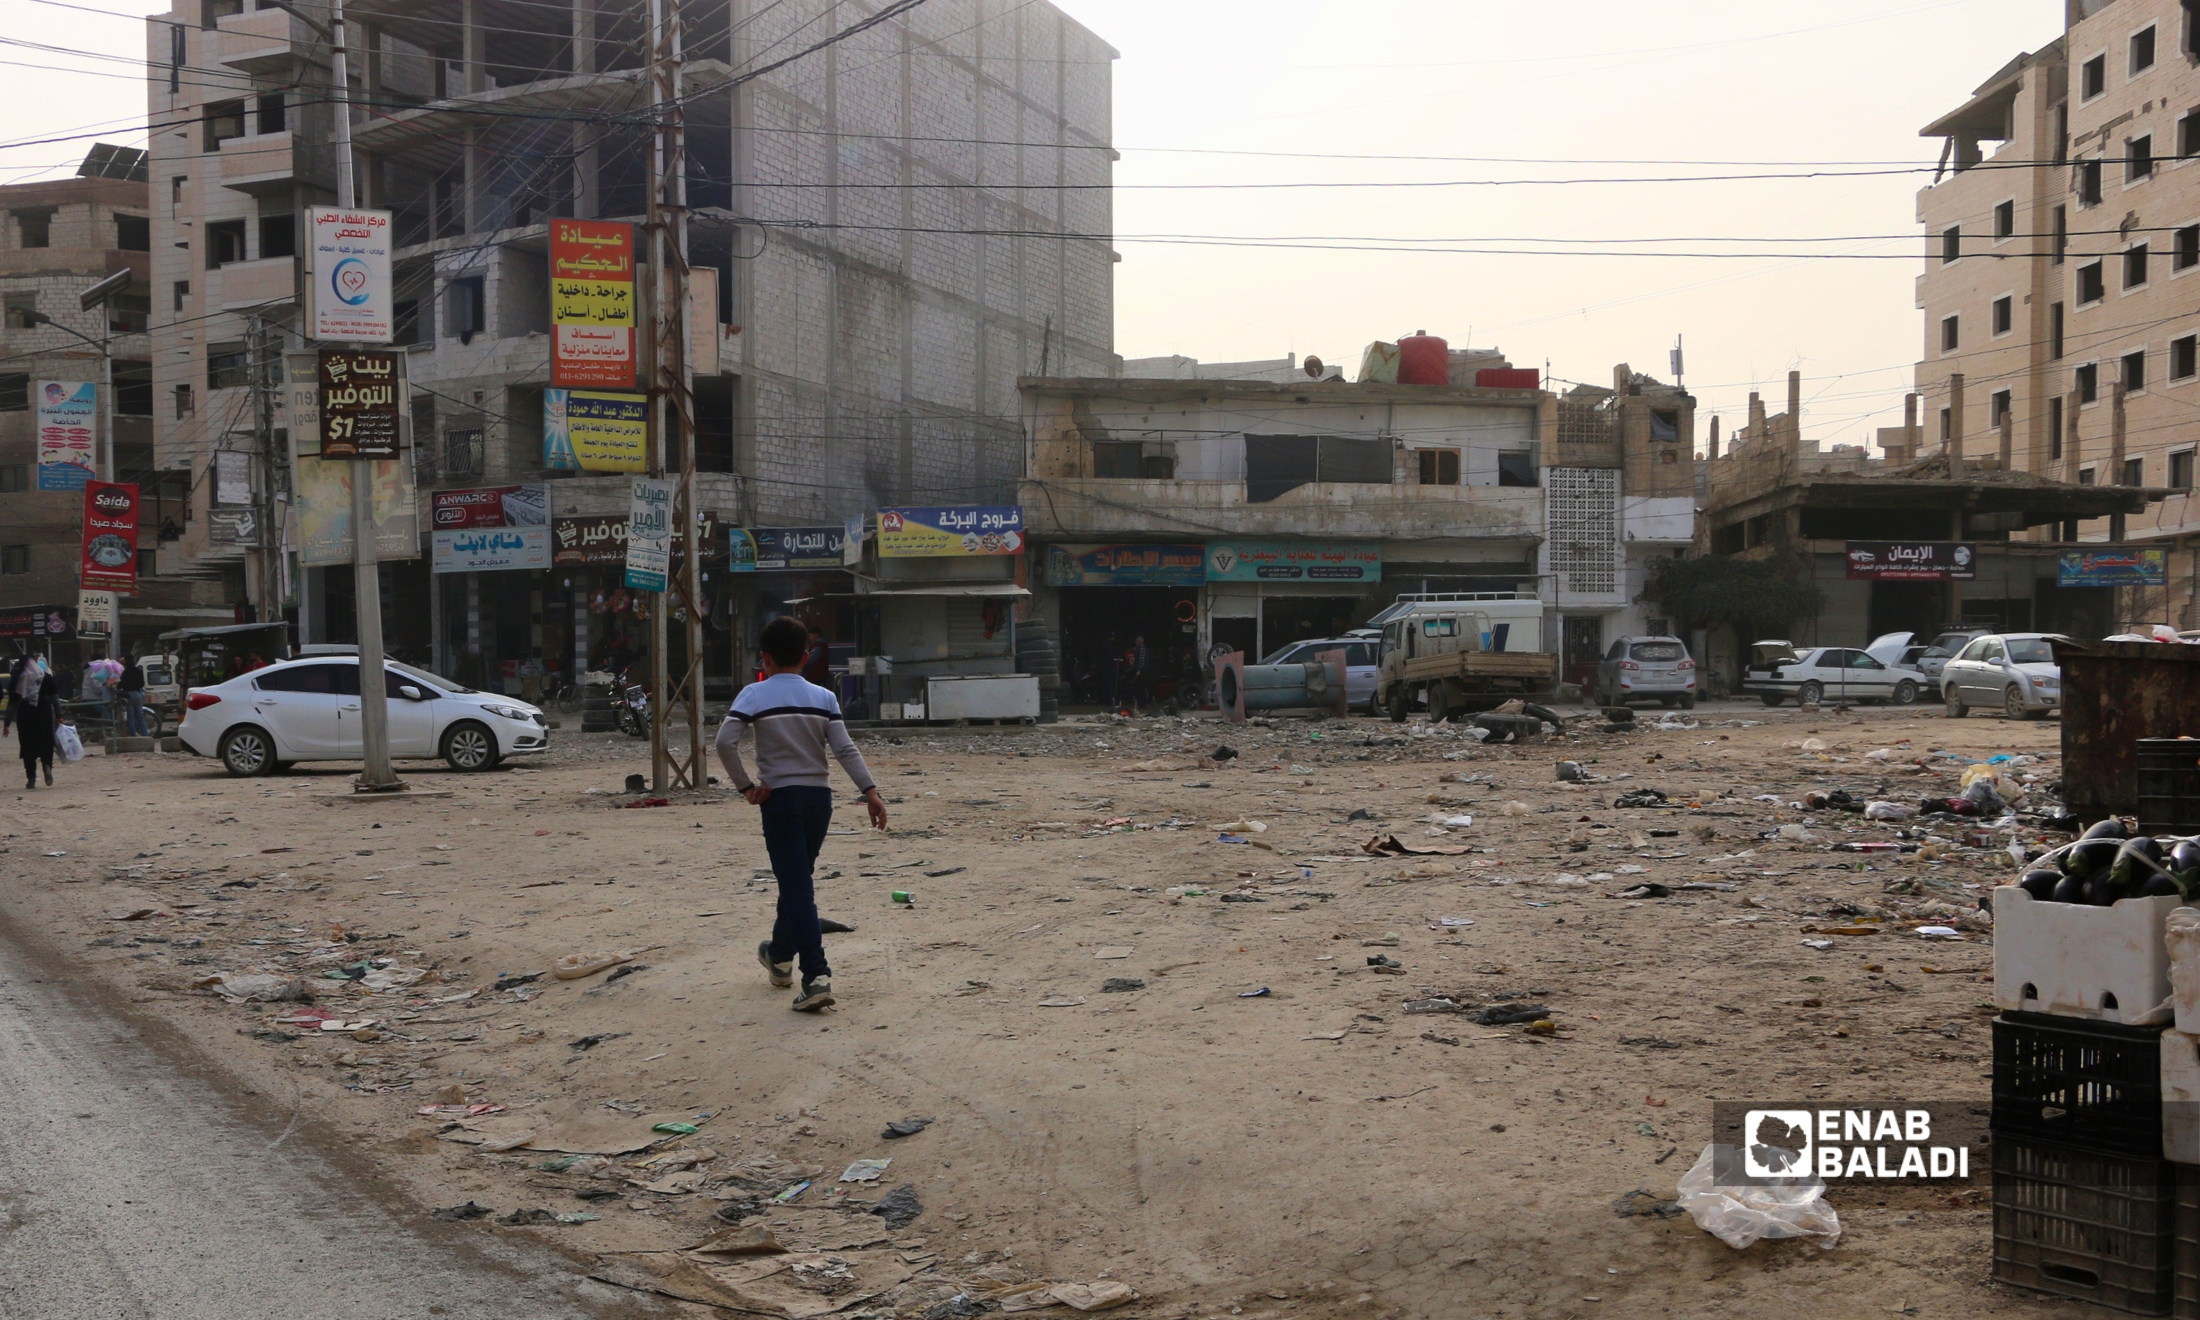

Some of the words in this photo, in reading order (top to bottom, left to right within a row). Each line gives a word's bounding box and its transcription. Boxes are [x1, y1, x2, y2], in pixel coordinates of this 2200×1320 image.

[317, 214, 339, 226] الطبي
[342, 214, 365, 224] الشفاء
[367, 217, 386, 228] مركز
[335, 229, 370, 240] التخصصي
[560, 225, 623, 249] عيادة
[557, 253, 628, 274] الحكيم
[558, 283, 589, 298] داخلية
[597, 285, 627, 301] جراحة
[557, 304, 590, 320] أسنان
[598, 306, 629, 321] أطفال
[572, 328, 616, 340] اسعاف
[562, 344, 590, 357] منزلية
[592, 345, 625, 358] معاينات
[352, 356, 391, 379] بيت
[326, 383, 392, 410] التوفير
[569, 401, 589, 416] حمودة
[590, 402, 602, 415] الله
[603, 407, 617, 419] عبد
[618, 405, 643, 419] الدكتور
[328, 416, 354, 440] $1
[604, 424, 622, 435] الداخلية
[583, 438, 600, 446] الجمعة
[609, 440, 625, 449] العيادة
[96, 495, 130, 507] Saida
[634, 483, 669, 507] بصريات
[90, 518, 110, 527] صيدا
[111, 520, 133, 530] سجاد
[633, 504, 666, 533] الأمير
[939, 511, 977, 529] البركة
[981, 511, 1019, 529] فروج
[582, 520, 629, 546] توفير
[784, 532, 825, 554] للتجارة
[1095, 550, 1159, 571] الإطارات
[1238, 546, 1283, 563] البيطرية
[1286, 546, 1318, 564] للعناية
[1321, 546, 1350, 564] الهيثم
[1353, 548, 1378, 564] عيادة
[1888, 546, 1933, 564] الإيمان
[487, 559, 510, 567] معرض
[2082, 552, 2144, 573] المصري
[84, 597, 109, 606] داوود
